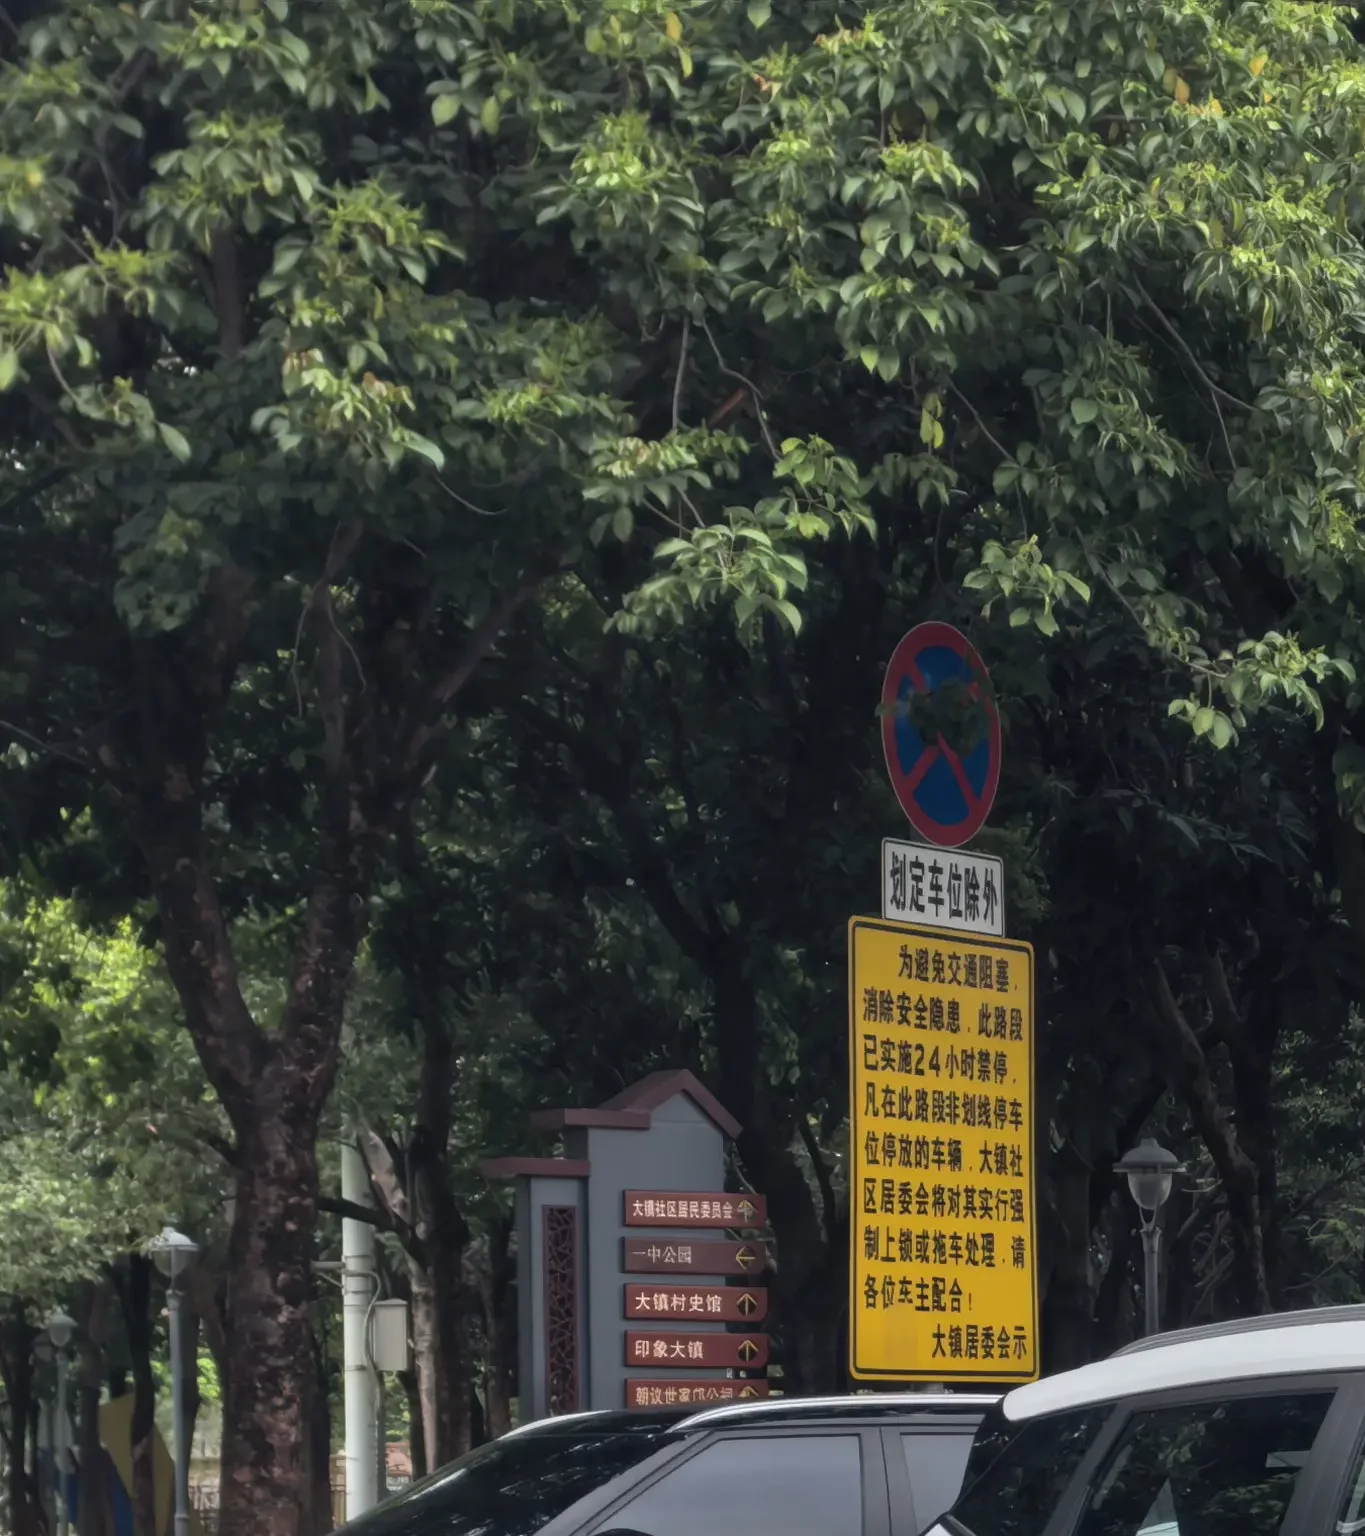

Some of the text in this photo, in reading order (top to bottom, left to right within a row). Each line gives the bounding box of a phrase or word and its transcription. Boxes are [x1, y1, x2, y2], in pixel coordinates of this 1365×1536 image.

[890, 851, 998, 926] 划定车位除外
[864, 1082, 1023, 1132] 凡在此路段非划线停车
[632, 1199, 733, 1219] 大镇社区居民委员会
[863, 1177, 1025, 1223] 区居委会将对其实行强
[632, 1244, 692, 1264] 一中公园
[635, 1291, 722, 1313] 大镇村史馆
[635, 1339, 704, 1360] 印象大镇
[931, 1323, 1027, 1361] 大镇居委会示
